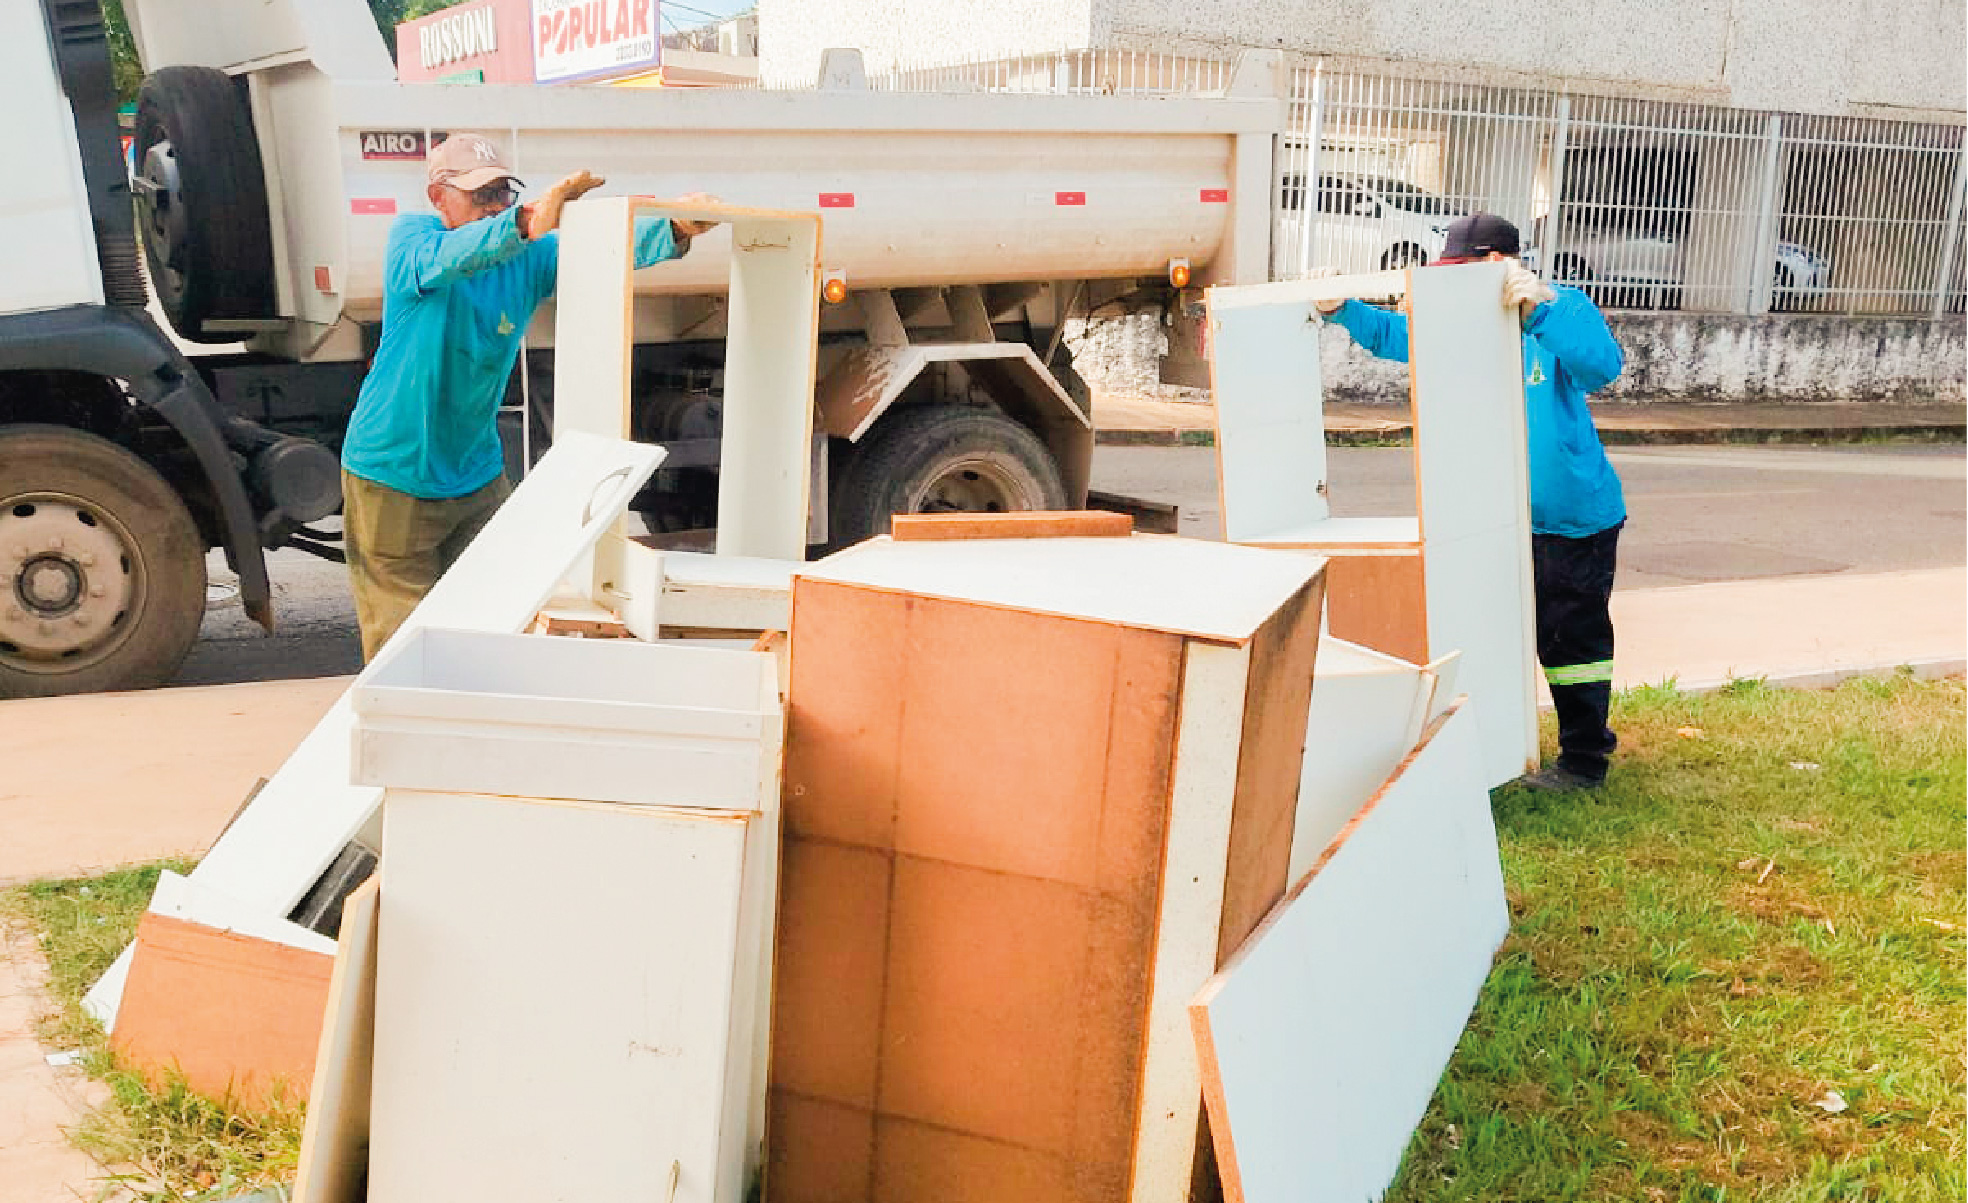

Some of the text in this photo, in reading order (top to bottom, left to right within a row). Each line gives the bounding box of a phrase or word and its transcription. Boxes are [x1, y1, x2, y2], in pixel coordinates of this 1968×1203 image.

[419, 5, 497, 69] ROSSONI
[538, 0, 650, 58] POPULAR
[363, 133, 417, 153] AIRO
